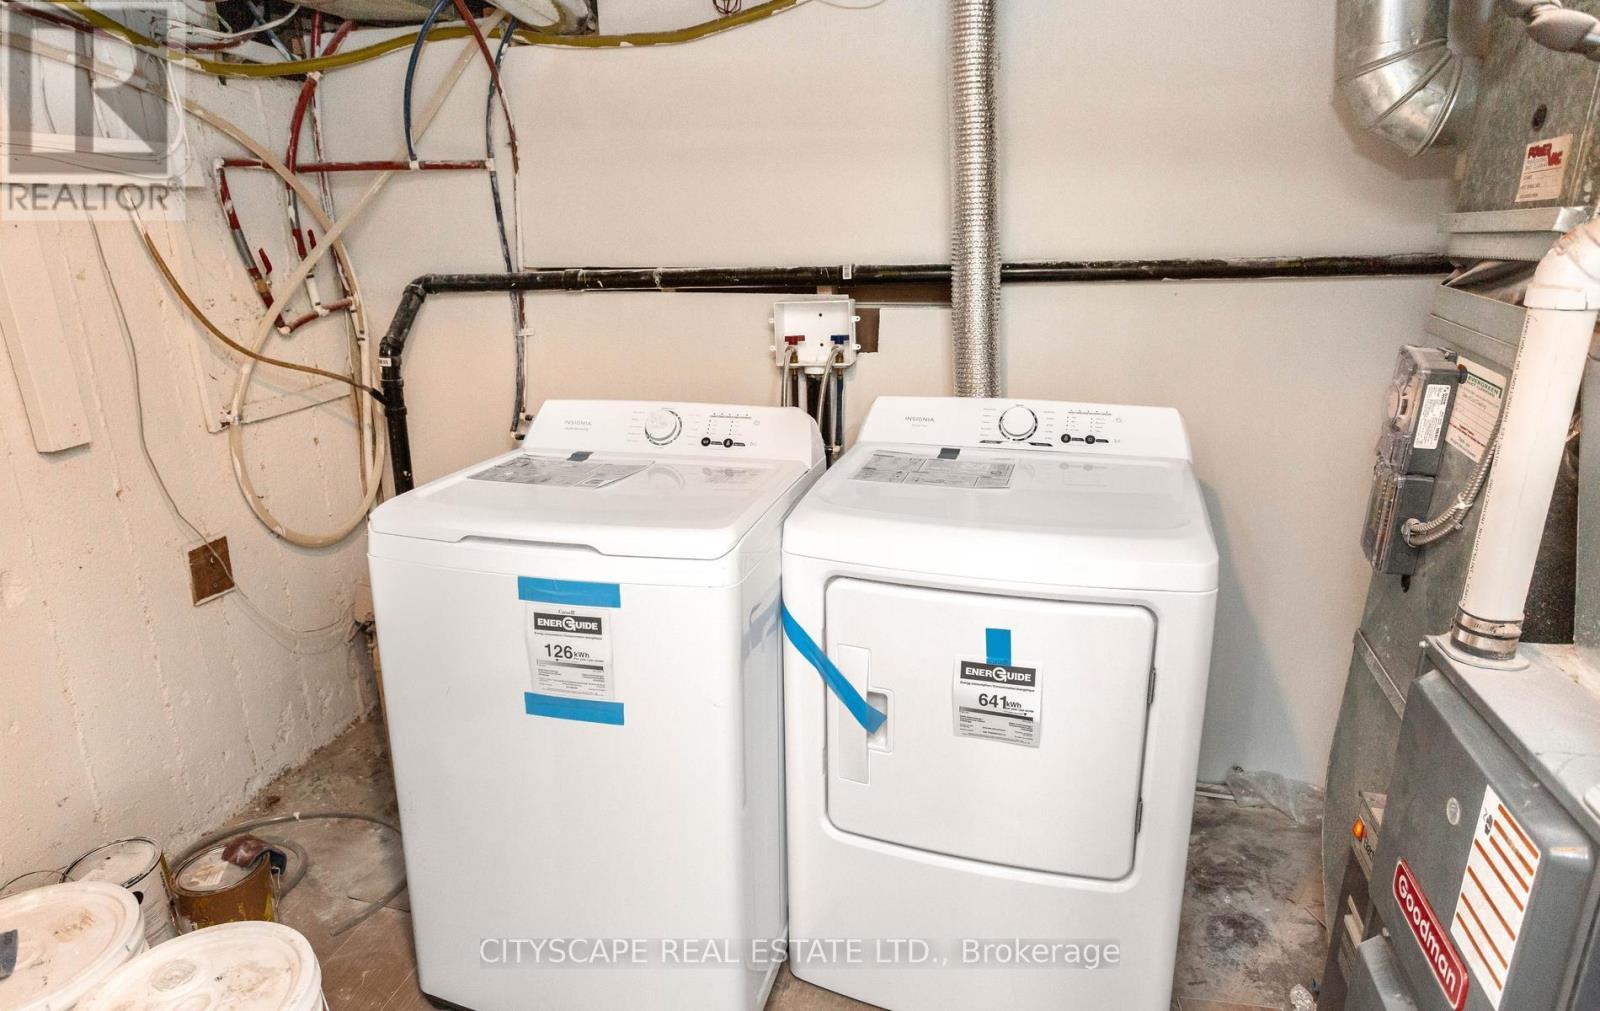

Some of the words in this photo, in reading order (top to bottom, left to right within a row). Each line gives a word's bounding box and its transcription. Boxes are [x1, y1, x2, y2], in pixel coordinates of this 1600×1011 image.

[1467, 375, 1500, 396] EVERGREEN
[537, 616, 599, 631] ENERGUIDE
[544, 644, 573, 659] 126
[573, 651, 590, 659] kWh
[965, 667, 1032, 682] ENERGUIDE
[978, 693, 1007, 709] 641
[1398, 874, 1456, 993] Goodman
